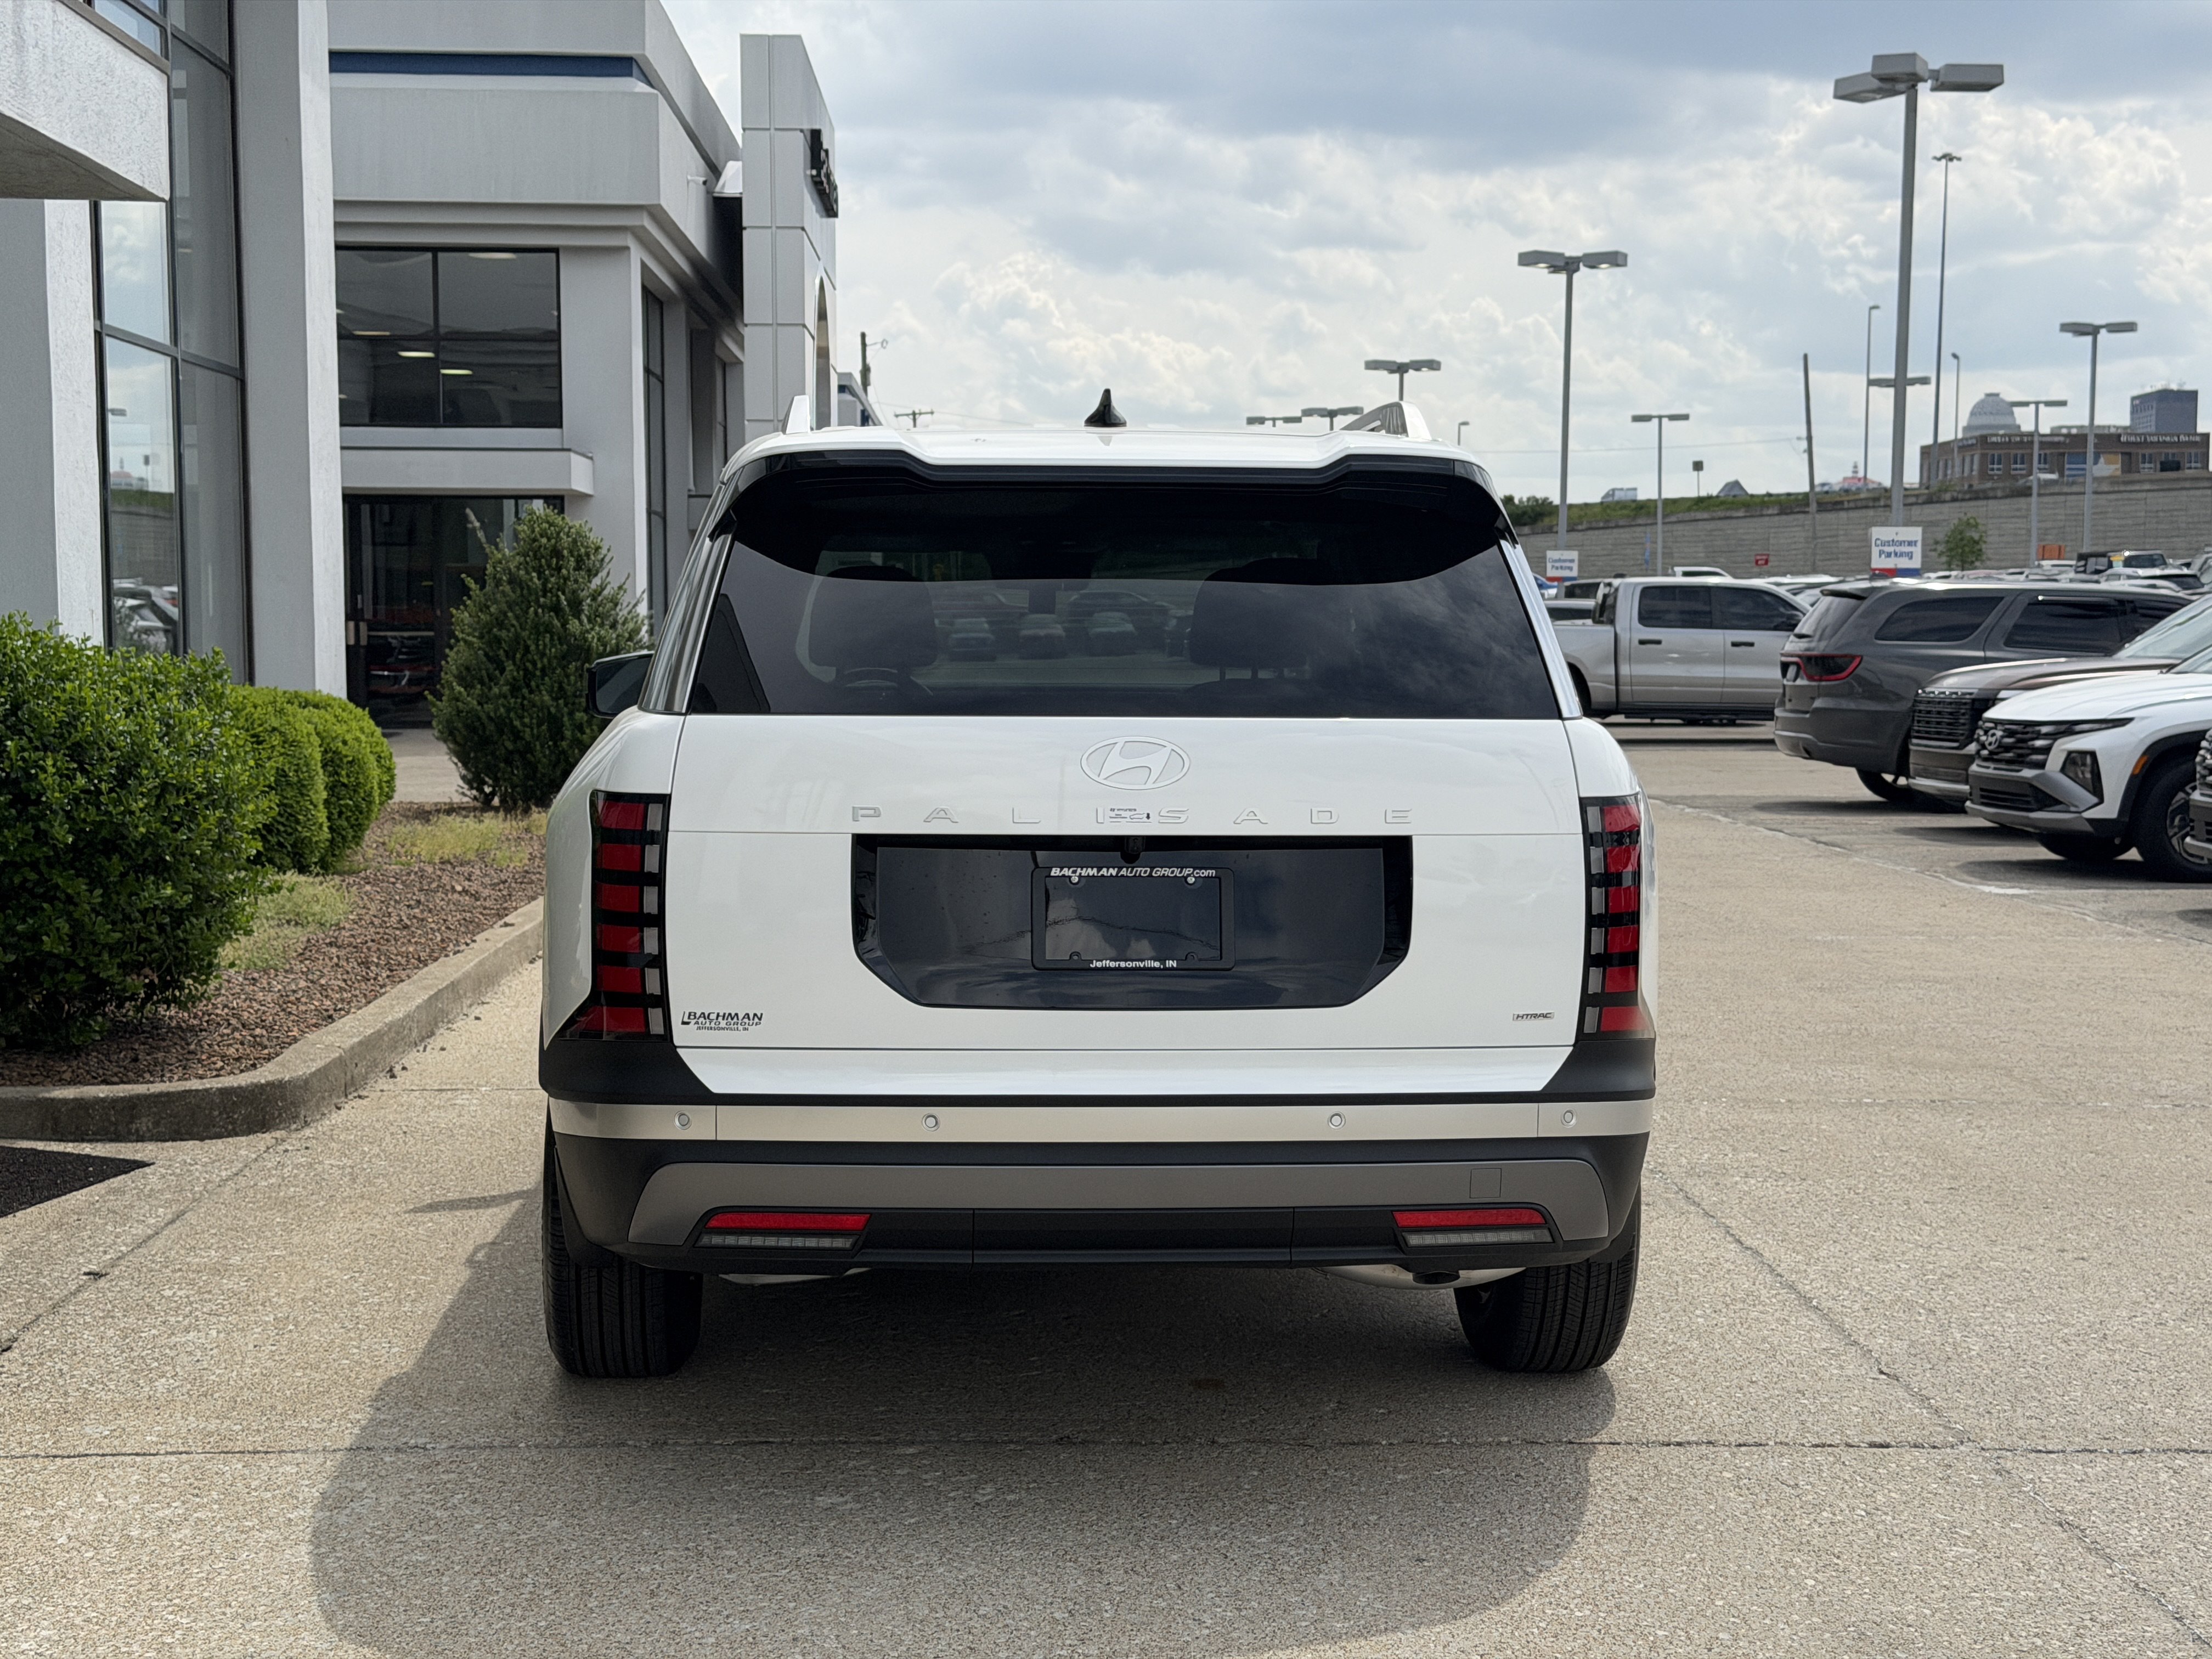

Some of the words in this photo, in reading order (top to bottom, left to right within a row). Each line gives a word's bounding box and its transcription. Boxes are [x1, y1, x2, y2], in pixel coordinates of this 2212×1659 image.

[1874, 538, 1918, 547] Customer
[1878, 549, 1914, 560] Parking
[851, 805, 1412, 824] PALISADE
[1050, 867, 1118, 876] BACHMAN
[1118, 867, 1150, 877] AUTO
[1152, 868, 1216, 877] GROUP.com
[1090, 960, 1164, 969] Jeffersonville,
[687, 1011, 763, 1022] BACHMAN
